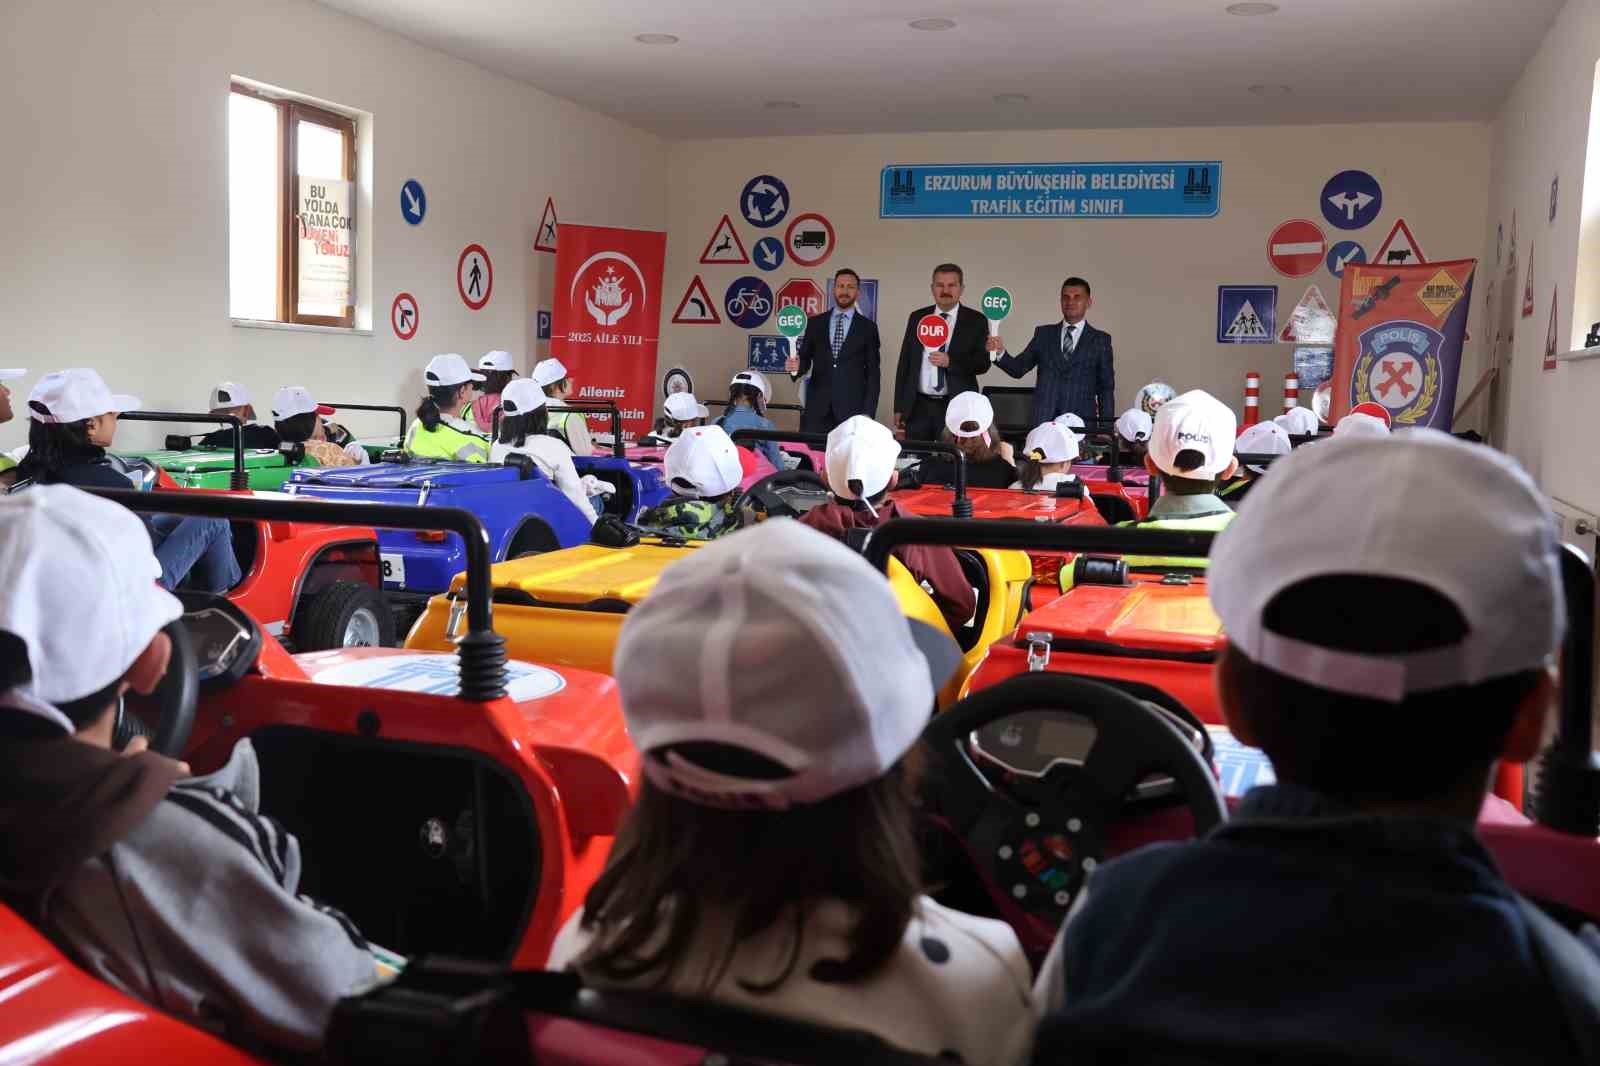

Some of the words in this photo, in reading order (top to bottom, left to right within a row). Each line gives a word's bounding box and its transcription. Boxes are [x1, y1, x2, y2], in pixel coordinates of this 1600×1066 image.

[924, 175, 992, 191] ERZURUM
[996, 171, 1086, 194] BÜYÜKŞEHİR
[1091, 169, 1176, 190] BELEDİYESİ
[310, 185, 325, 198] BU
[304, 198, 339, 214] YOLDA
[970, 196, 1021, 214] TRAFİK
[1025, 195, 1076, 214] EĞİTİM
[1080, 199, 1125, 214] SINIFI
[983, 296, 1008, 311] GEÇ
[540, 313, 549, 336] P
[778, 314, 803, 329] GEÇ
[920, 325, 944, 337] DUR
